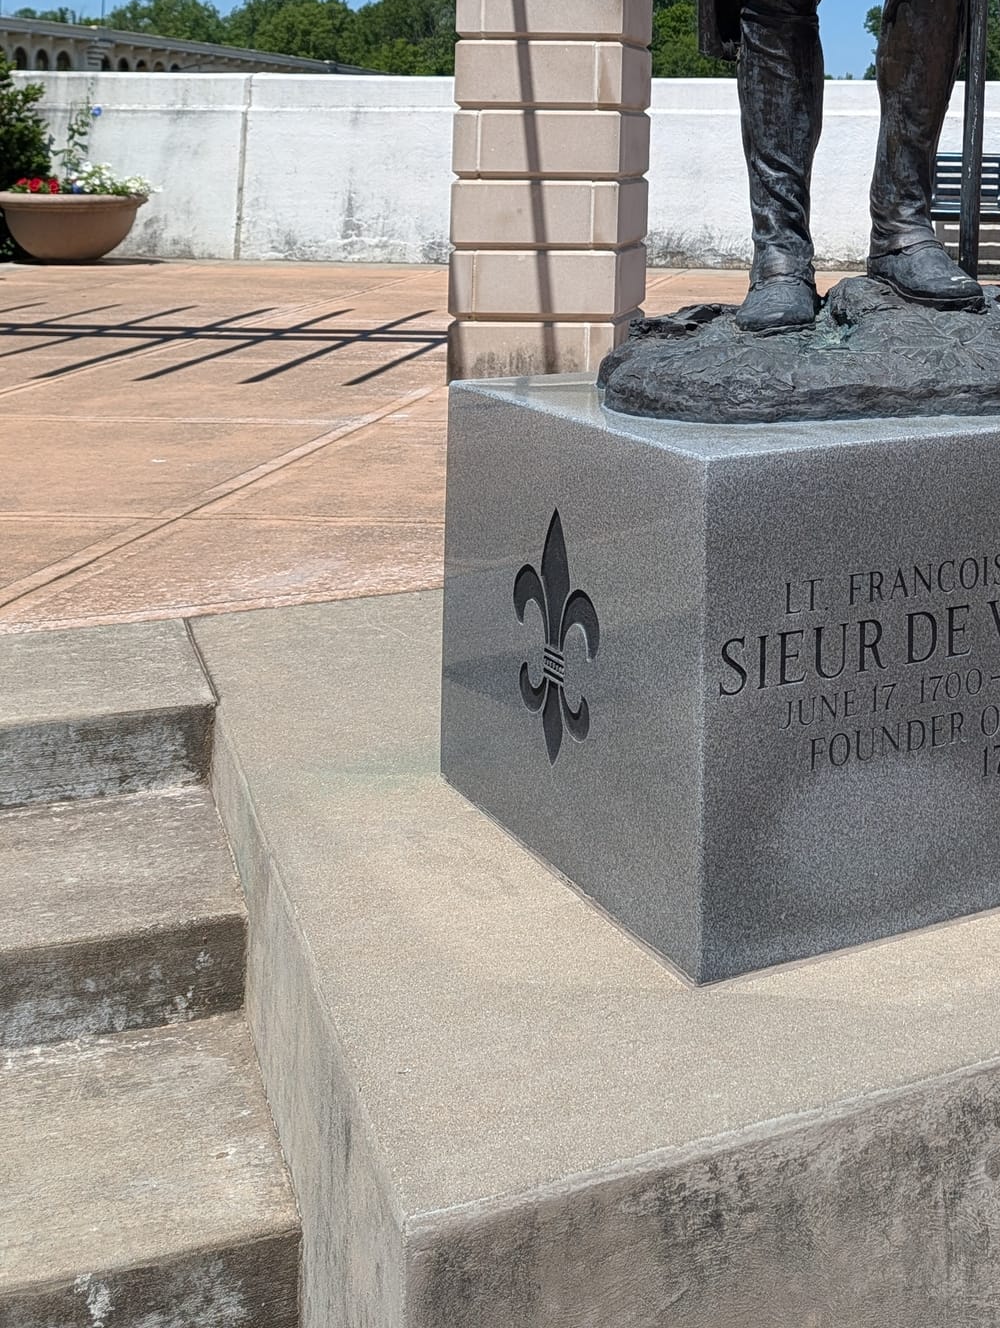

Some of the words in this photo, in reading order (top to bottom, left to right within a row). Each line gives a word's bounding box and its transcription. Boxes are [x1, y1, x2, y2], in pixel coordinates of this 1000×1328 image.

[719, 619, 888, 698] SIEUR
[904, 604, 972, 665] DE
[779, 689, 857, 730] JUNE
[919, 668, 982, 705] 1700
[810, 712, 967, 773] FOUNDER
